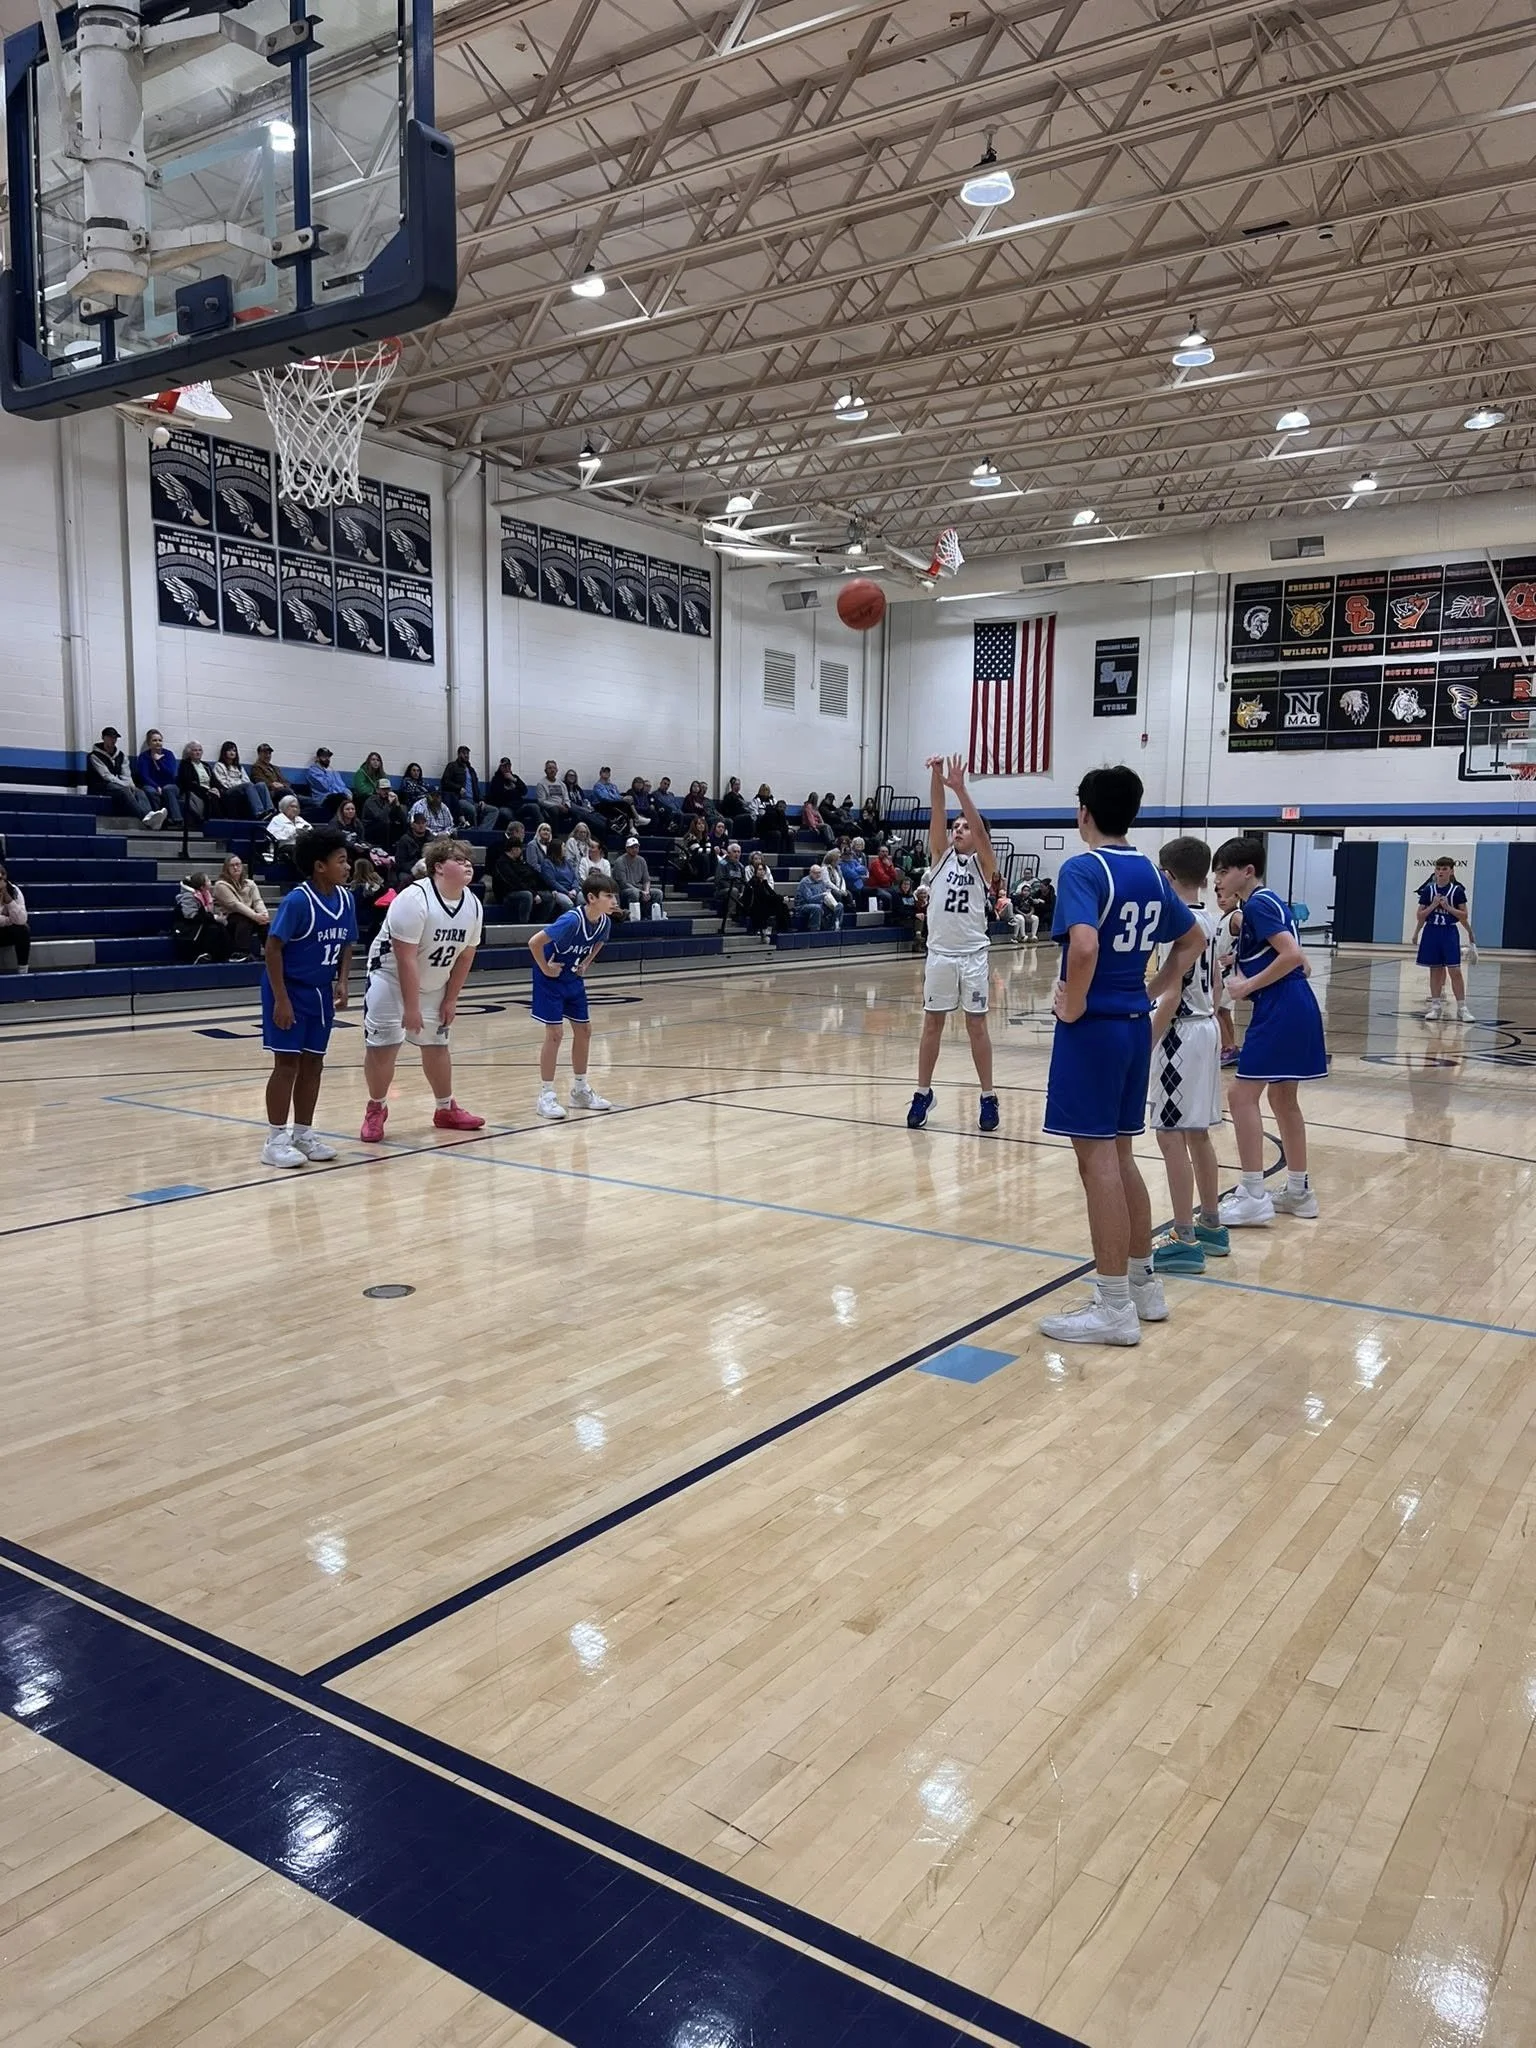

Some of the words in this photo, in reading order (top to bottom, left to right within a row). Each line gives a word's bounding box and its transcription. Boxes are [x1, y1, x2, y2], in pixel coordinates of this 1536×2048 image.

[171, 441, 209, 465] GIRLS
[215, 453, 232, 468] 7A
[235, 458, 269, 480] BOYS
[386, 497, 400, 510] 8A
[402, 501, 429, 520] BOYS
[157, 541, 176, 555] 8A
[179, 545, 215, 566] BOYS
[541, 539, 556, 551] 7AA
[557, 543, 576, 558] BOYS
[580, 549, 593, 560] 7AA
[221, 553, 239, 569] 7A
[242, 557, 276, 577] BOYS
[281, 565, 297, 580] 7A
[299, 569, 331, 588] BOYS
[1339, 576, 1385, 587] FRANKLIN
[336, 577, 356, 590] 7AA
[357, 580, 383, 598] BOYS
[388, 587, 406, 600] 8AA
[406, 590, 431, 607] GIRLS
[1282, 647, 1329, 657] WILDCATS
[1342, 643, 1375, 653] VIPERS
[1390, 639, 1434, 650] LANCERS
[1100, 661, 1133, 694] SV
[1413, 667, 1435, 675] FORK
[1102, 703, 1128, 711] STORM
[1284, 691, 1324, 716] N
[1287, 715, 1318, 725] MAC
[1388, 734, 1422, 743] PONIES
[946, 872, 975, 886] STORM
[944, 889, 969, 914] 22
[433, 928, 466, 943] STORM
[1112, 900, 1162, 952] 32
[320, 943, 341, 966] 12
[428, 946, 456, 967] 42
